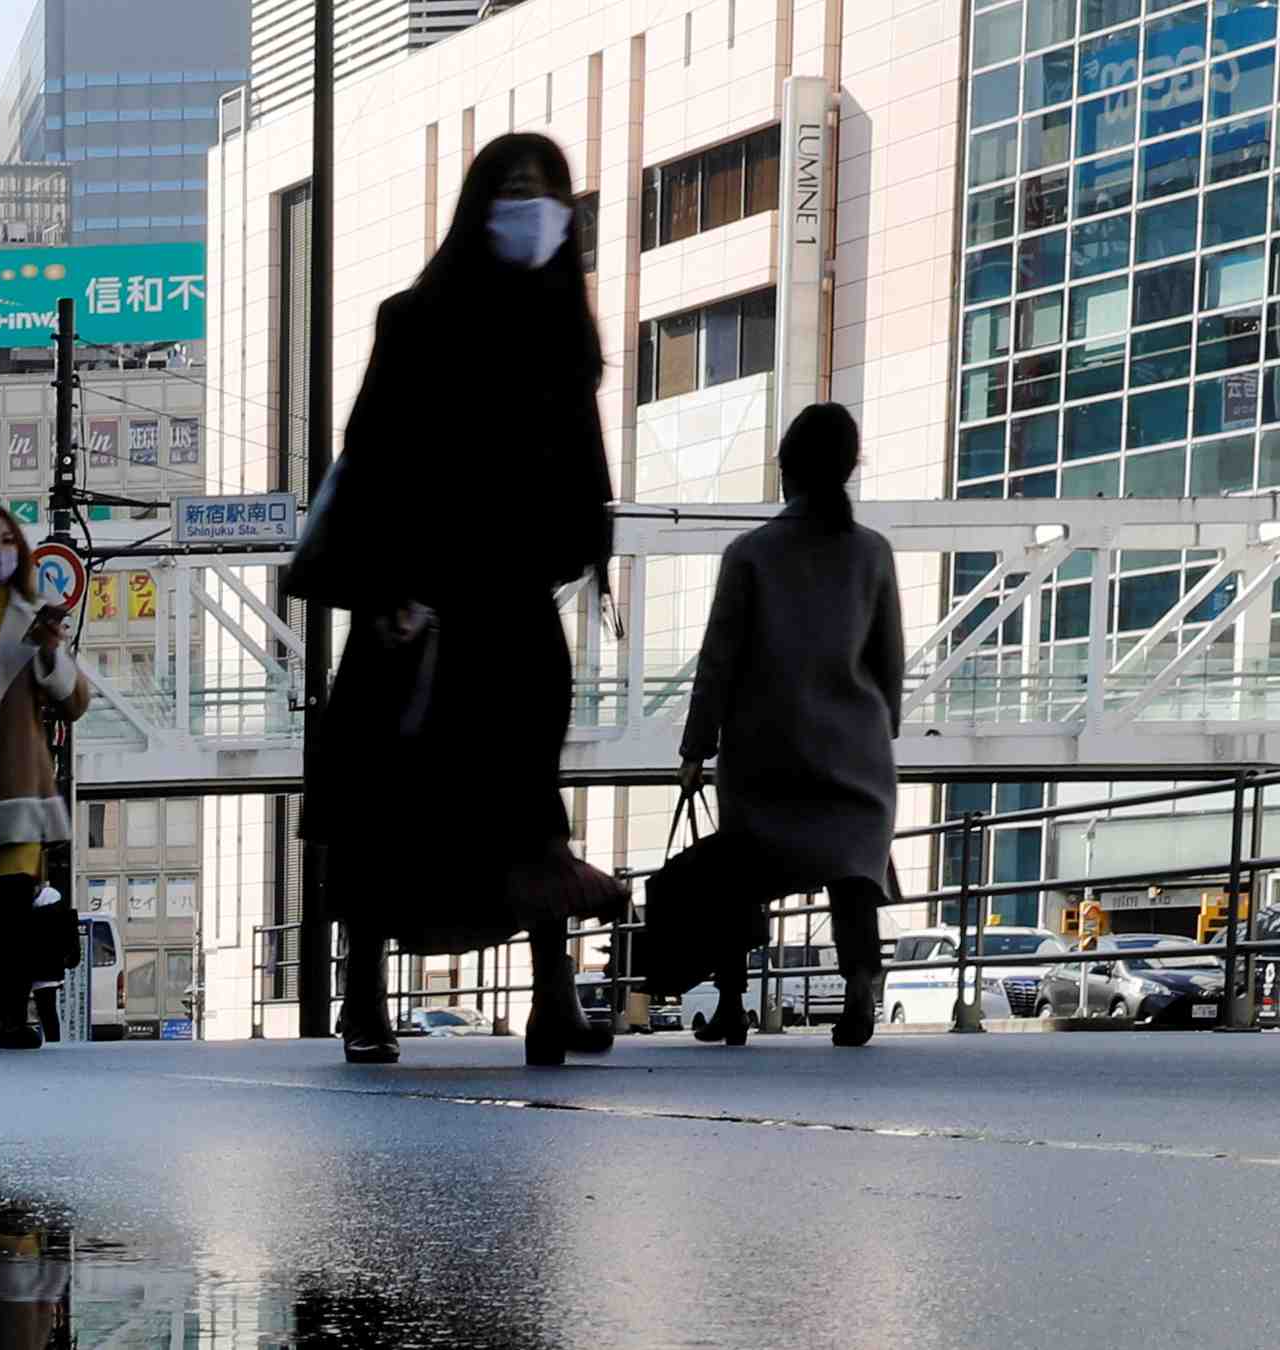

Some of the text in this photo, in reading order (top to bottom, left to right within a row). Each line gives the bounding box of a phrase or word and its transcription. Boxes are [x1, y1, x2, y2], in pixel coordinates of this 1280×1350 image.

[796, 124, 821, 225] LUMINE
[84, 274, 205, 314] 信和不
[185, 502, 287, 524] 新宿駅南口
[186, 525, 234, 537] Shinjuku
[238, 524, 257, 536] Sta.
